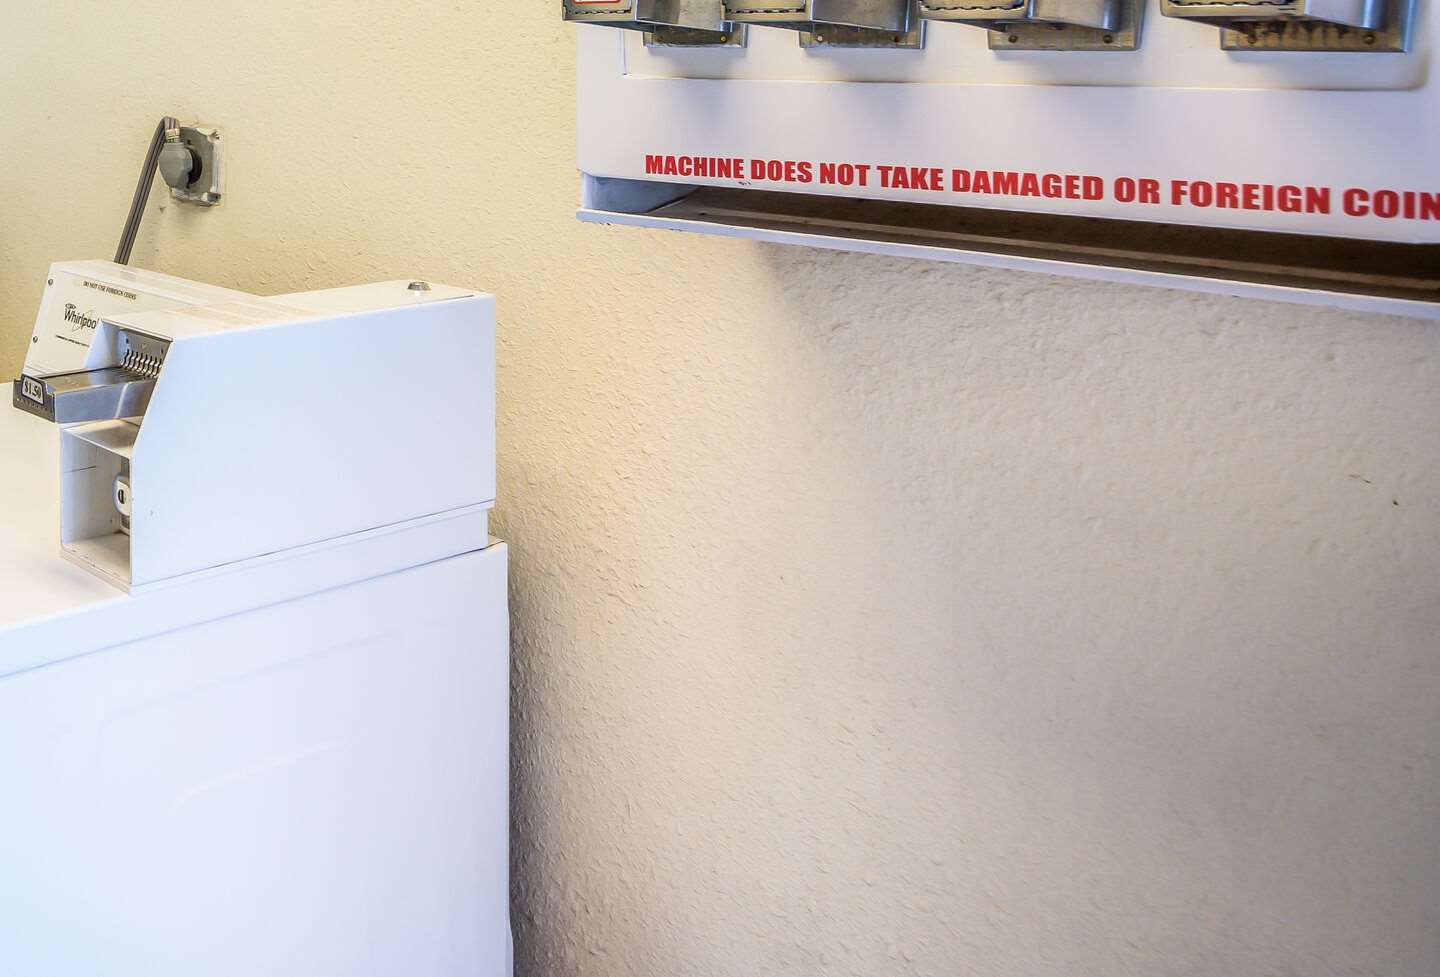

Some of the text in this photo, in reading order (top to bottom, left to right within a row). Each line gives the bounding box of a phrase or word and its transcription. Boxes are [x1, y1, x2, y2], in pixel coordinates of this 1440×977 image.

[645, 155, 744, 179] MACHINE
[750, 159, 813, 183] DOES
[820, 162, 870, 187] NOT
[877, 166, 944, 192] TAKE
[951, 169, 1104, 201] DAMAGED
[1113, 177, 1160, 204] OR
[1170, 180, 1330, 214] FOREIGN
[106, 286, 123, 296] FOREIGN
[24, 379, 42, 399] $1.50
